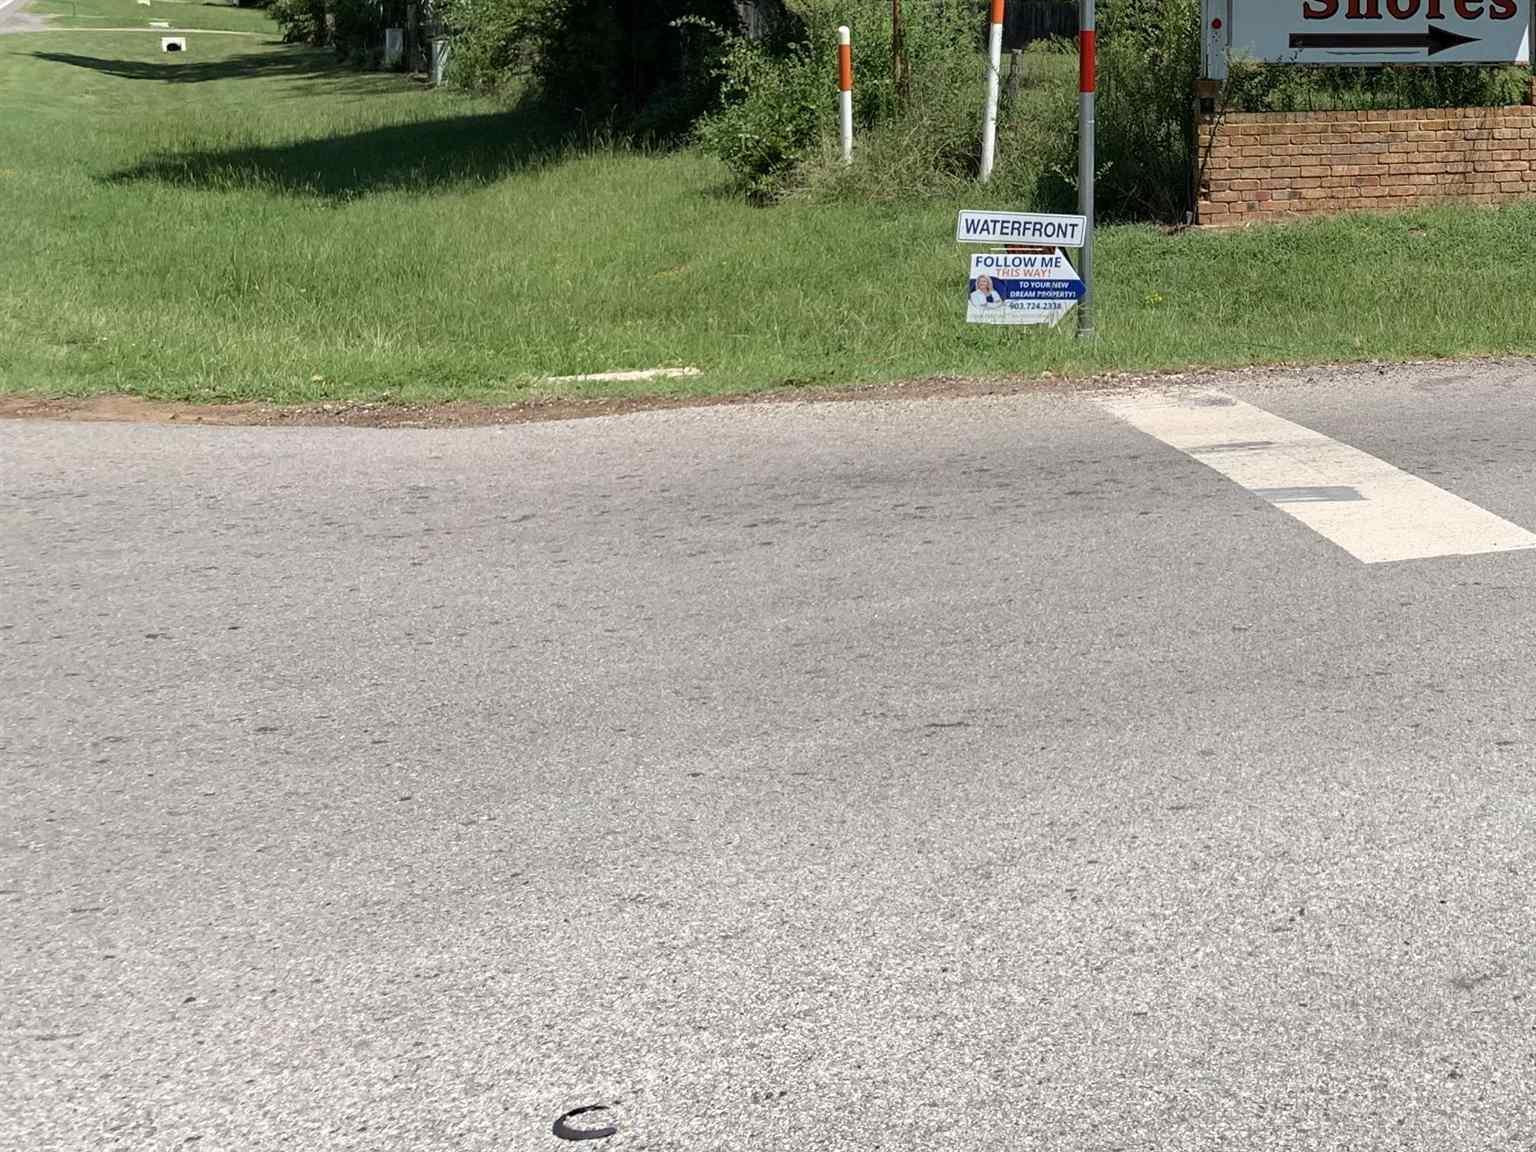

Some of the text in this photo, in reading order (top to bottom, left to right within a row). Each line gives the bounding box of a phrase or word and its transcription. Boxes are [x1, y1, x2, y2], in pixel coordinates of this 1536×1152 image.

[965, 218, 1079, 239] WATERFRONT
[976, 256, 1062, 268] FOLLOW ME
[996, 268, 1051, 278] THIS WAY!
[1020, 281, 1070, 289] TO YOUR NEW
[1010, 290, 1036, 298] DREAM
